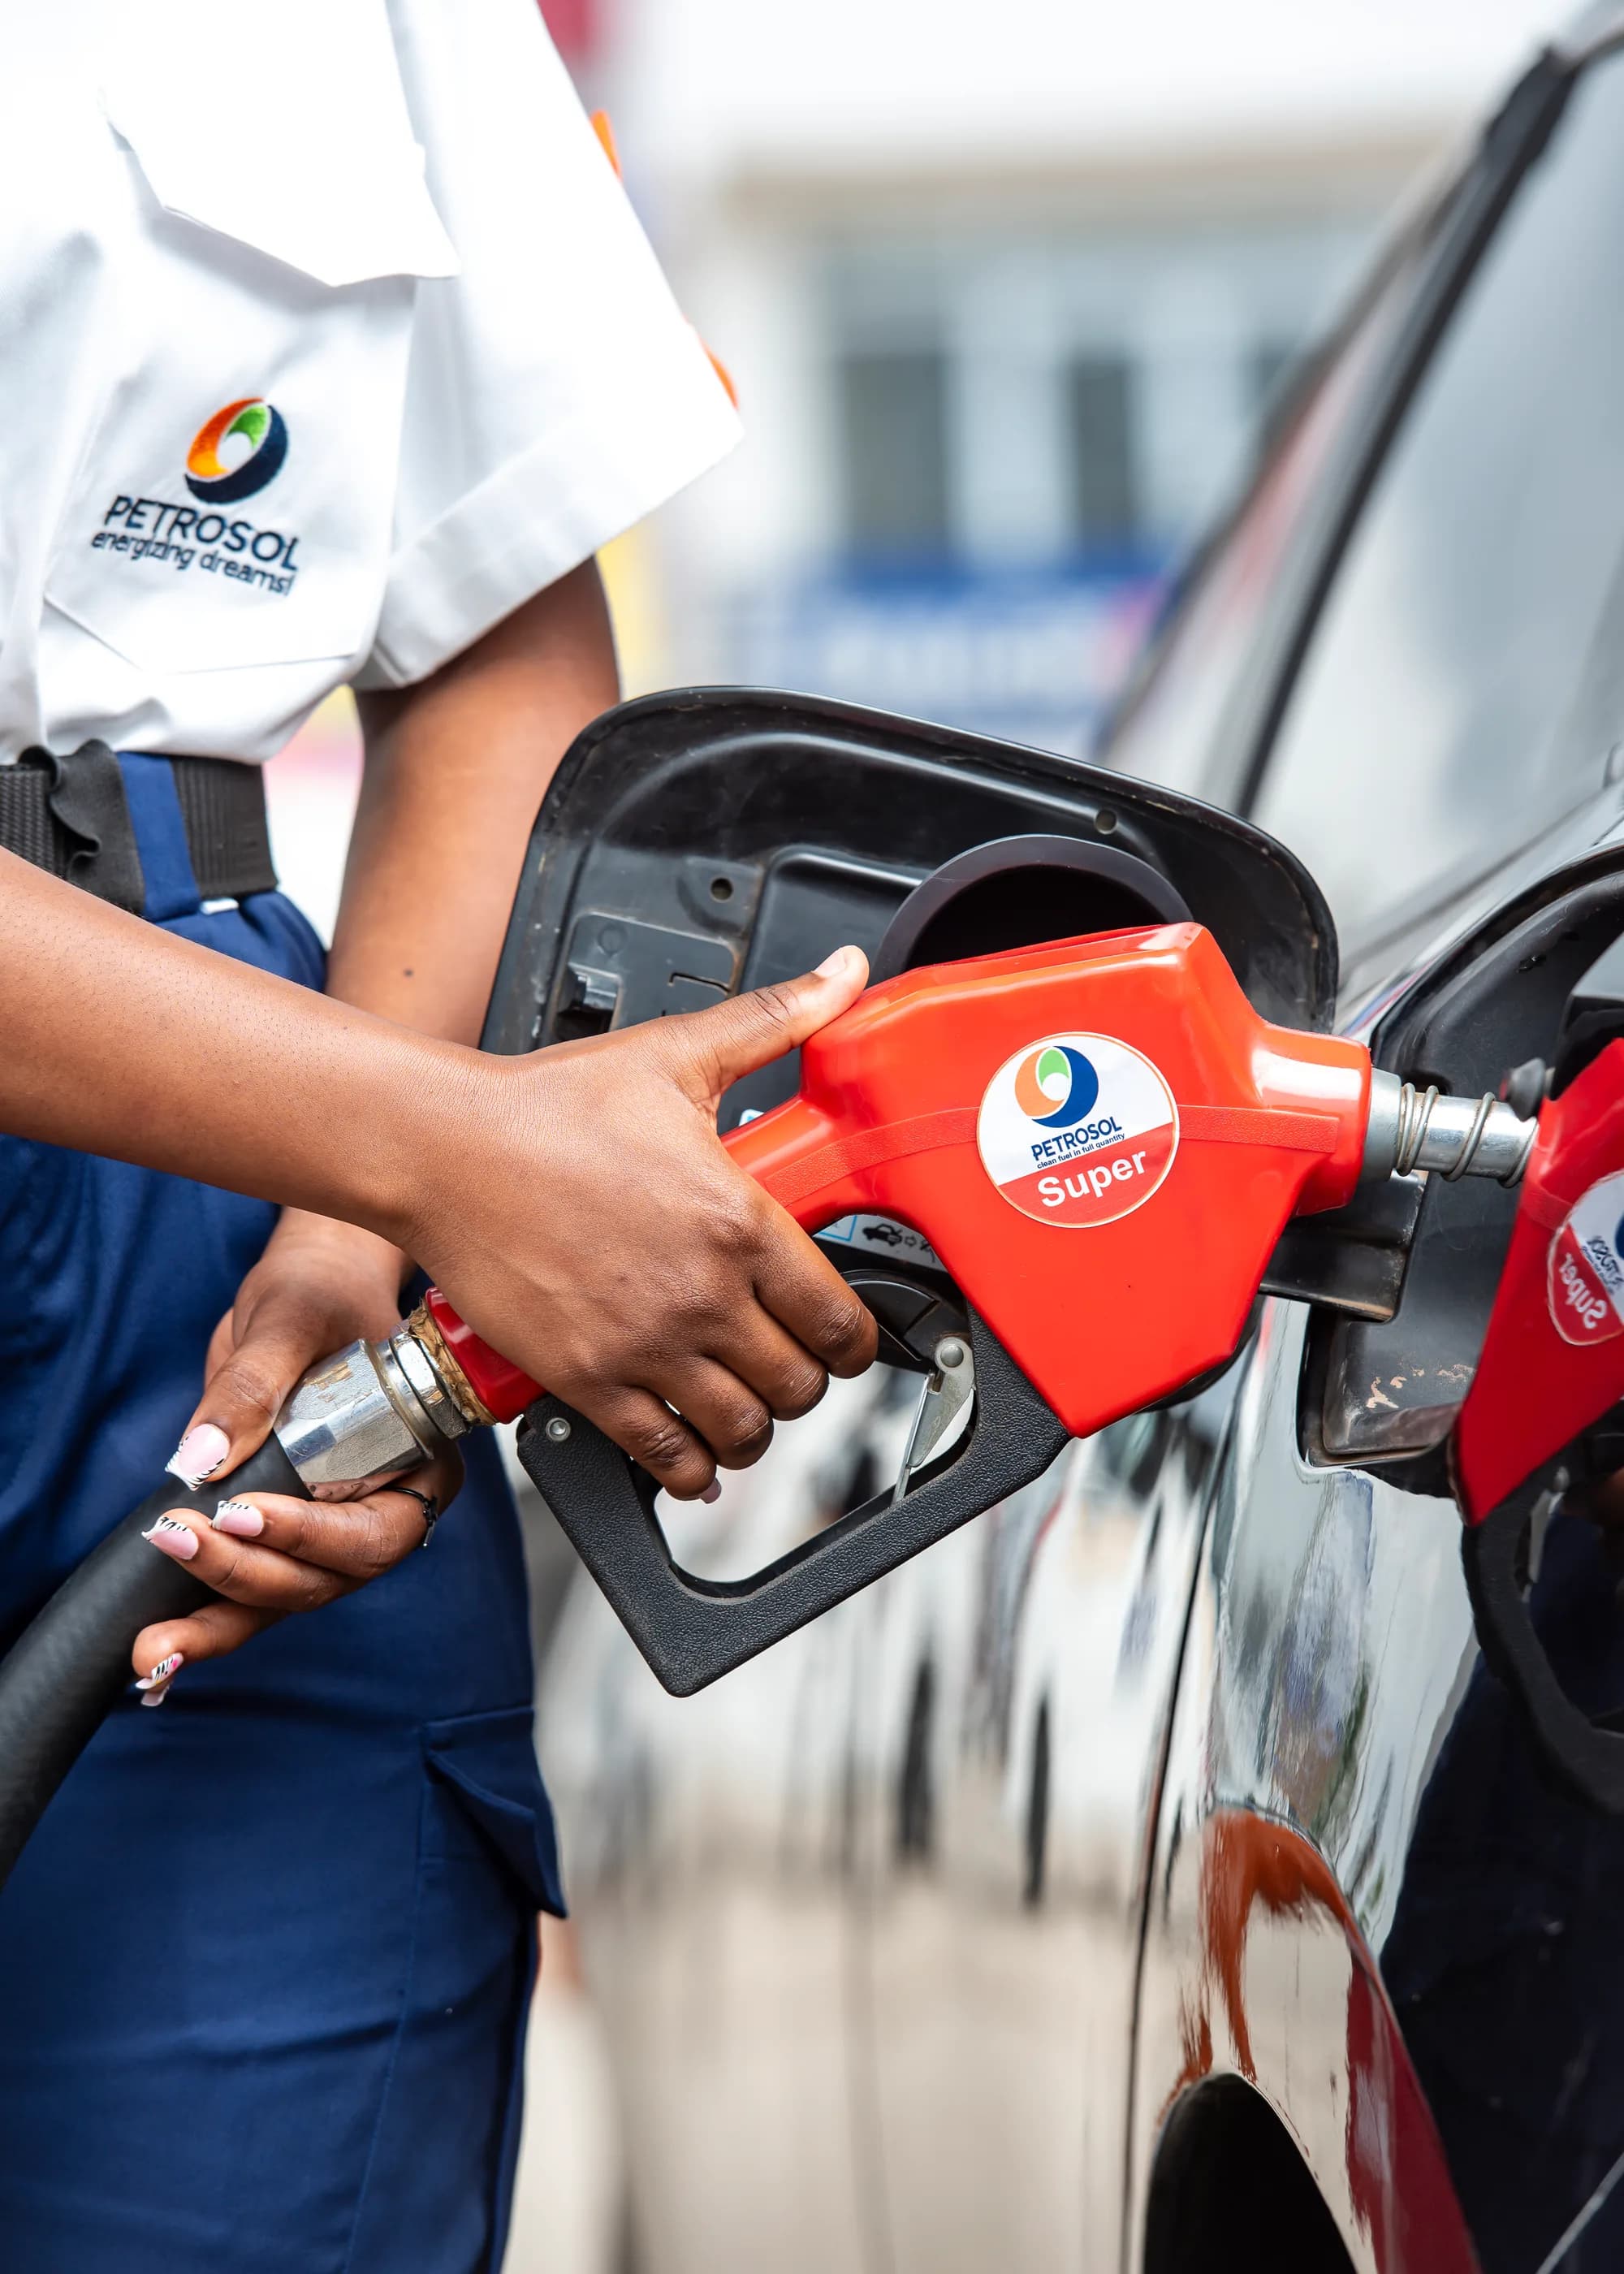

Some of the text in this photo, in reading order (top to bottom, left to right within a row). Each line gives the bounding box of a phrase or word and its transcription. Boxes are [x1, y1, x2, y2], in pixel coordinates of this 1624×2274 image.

[91, 530, 196, 571] energizing
[104, 495, 300, 572] PETROSOL
[1030, 1116, 1122, 1161] PETROSOL
[1037, 1157, 1057, 1169] clean
[1057, 1152, 1073, 1164] fuel
[1082, 1143, 1095, 1154] full
[1095, 1132, 1125, 1149] quantity
[1037, 1151, 1147, 1208] Super
